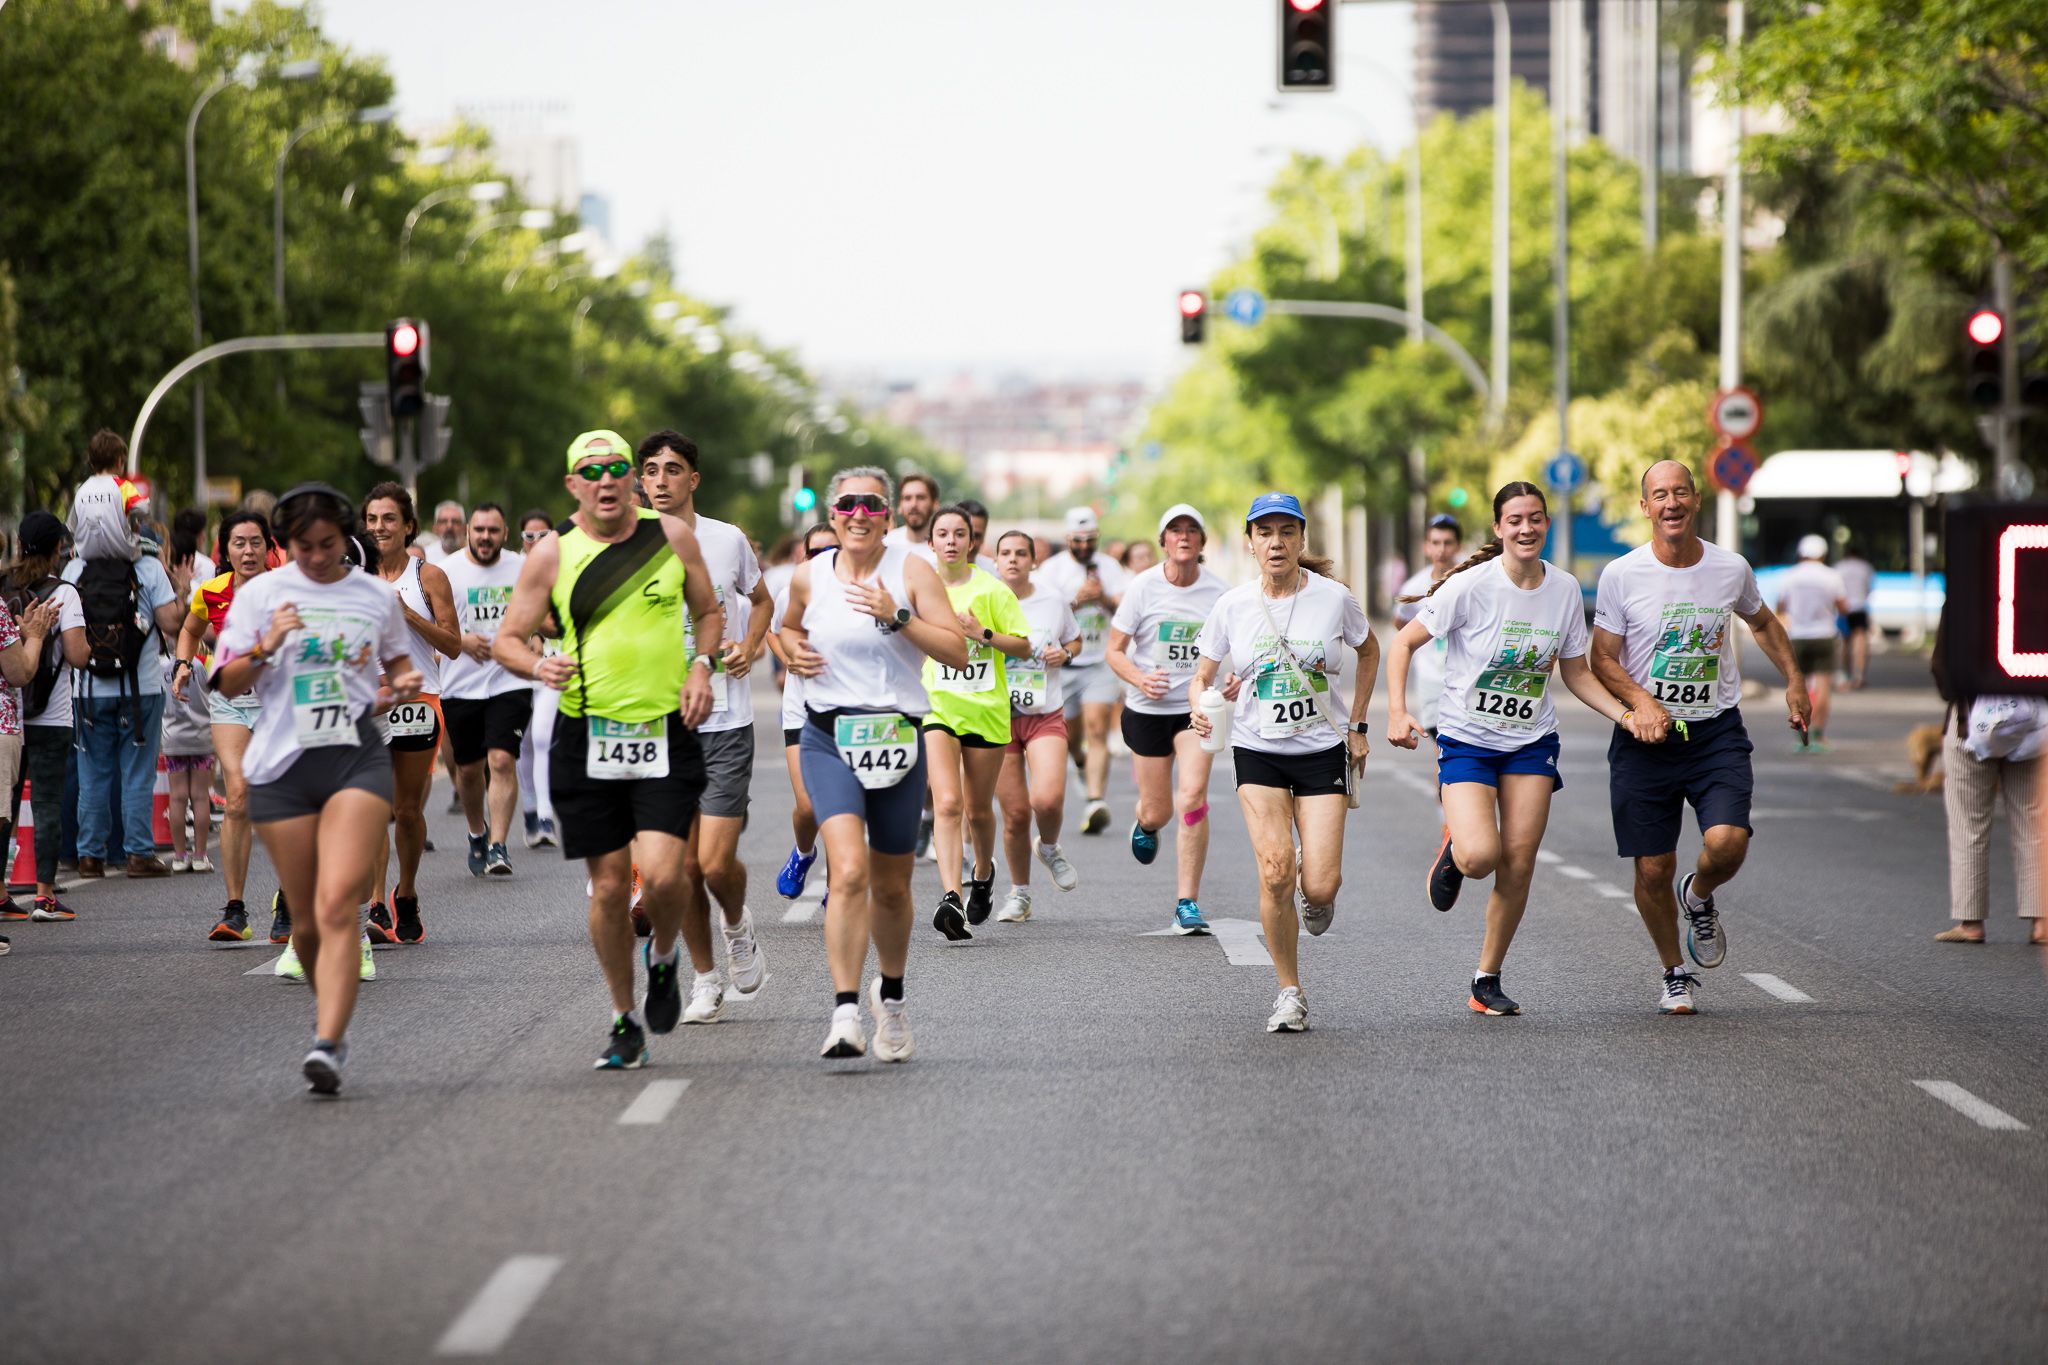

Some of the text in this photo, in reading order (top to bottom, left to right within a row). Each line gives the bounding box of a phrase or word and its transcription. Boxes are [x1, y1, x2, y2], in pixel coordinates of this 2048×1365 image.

[1662, 608, 1696, 617] MADRID
[1503, 626, 1560, 638] MADRID CON LA
[1168, 645, 1200, 661] 519
[1312, 639, 1323, 647] LA
[1664, 661, 1706, 680] ELA
[1489, 673, 1531, 693] ELA
[1653, 681, 1711, 704] 1284
[389, 705, 427, 724] 604
[1272, 697, 1318, 724] 201
[1475, 691, 1533, 719] 1286
[851, 722, 899, 745] ELA
[598, 741, 658, 765] 1438
[845, 748, 909, 772] 1442
